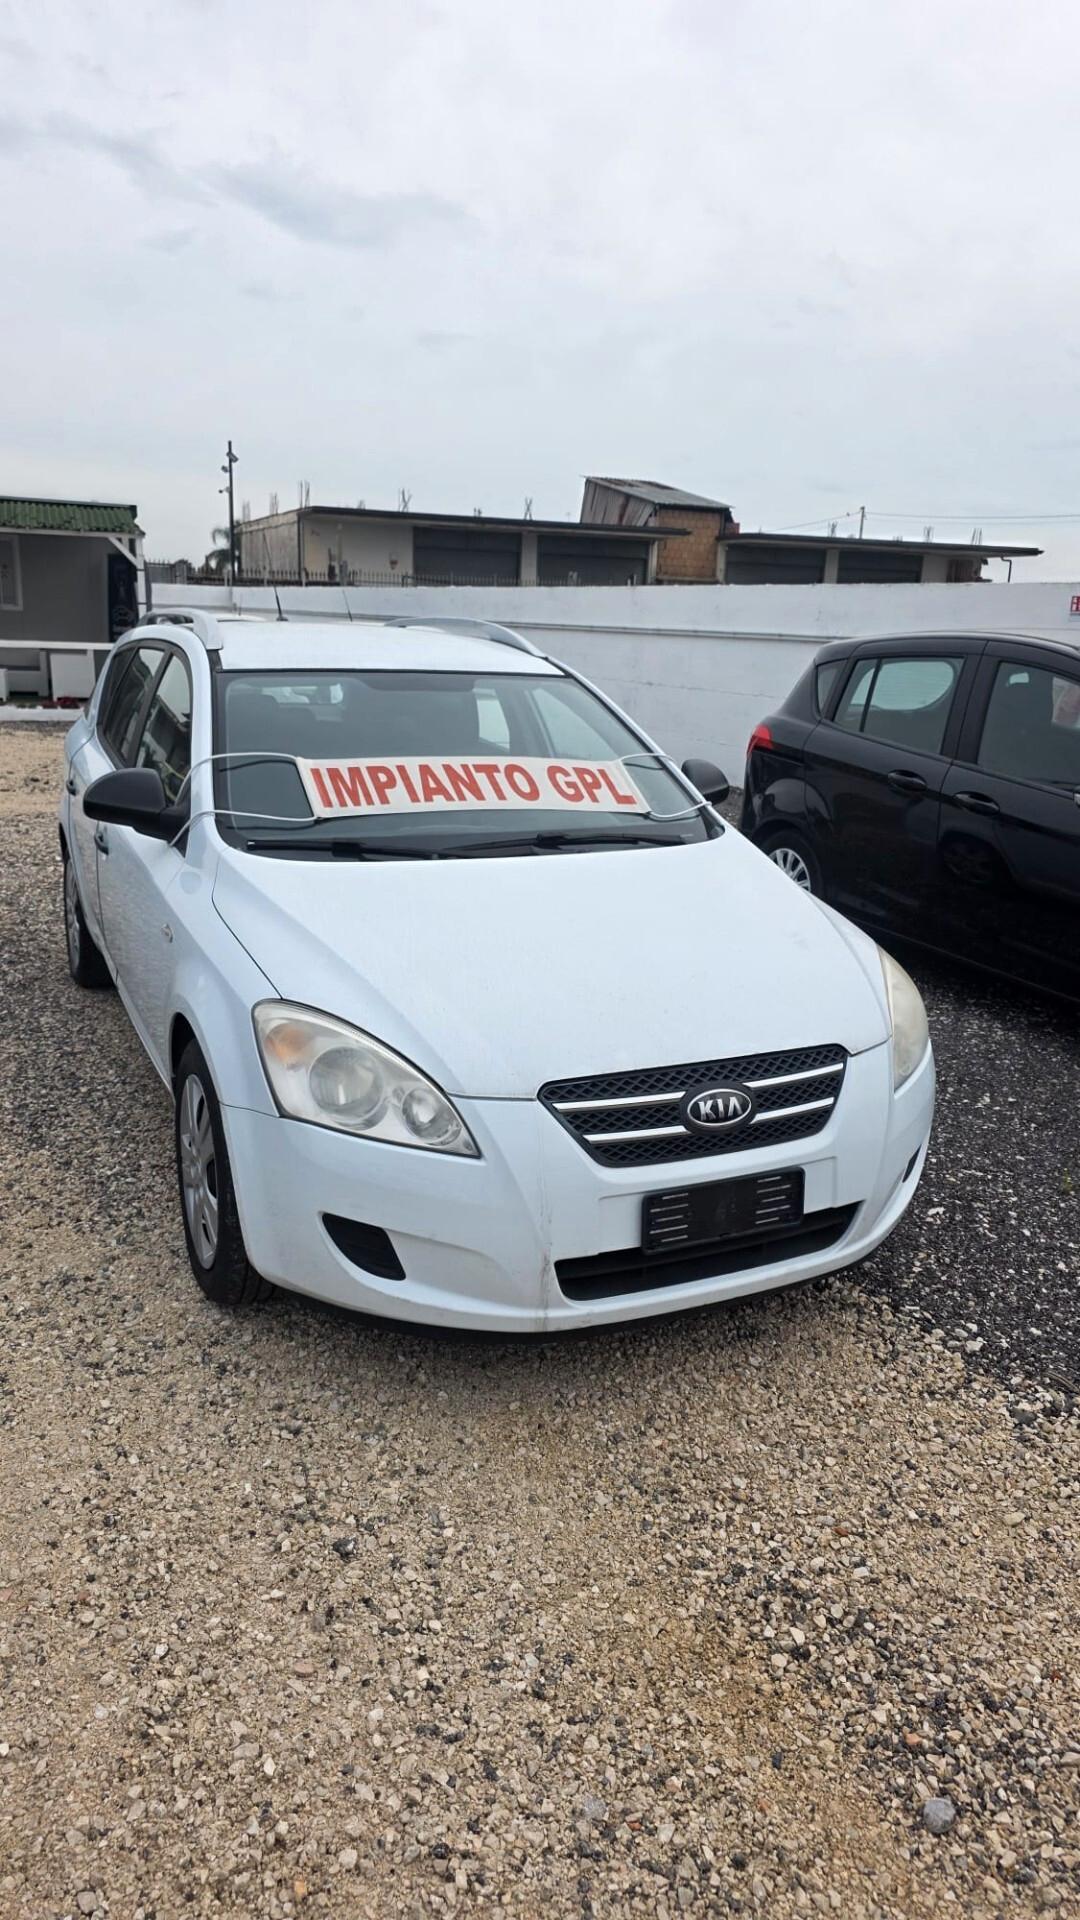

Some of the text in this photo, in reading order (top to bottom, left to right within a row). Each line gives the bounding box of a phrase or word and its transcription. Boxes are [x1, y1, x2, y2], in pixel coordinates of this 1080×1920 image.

[310, 763, 636, 808] IMPIANTO GPL
[697, 1096, 743, 1121] KIA
